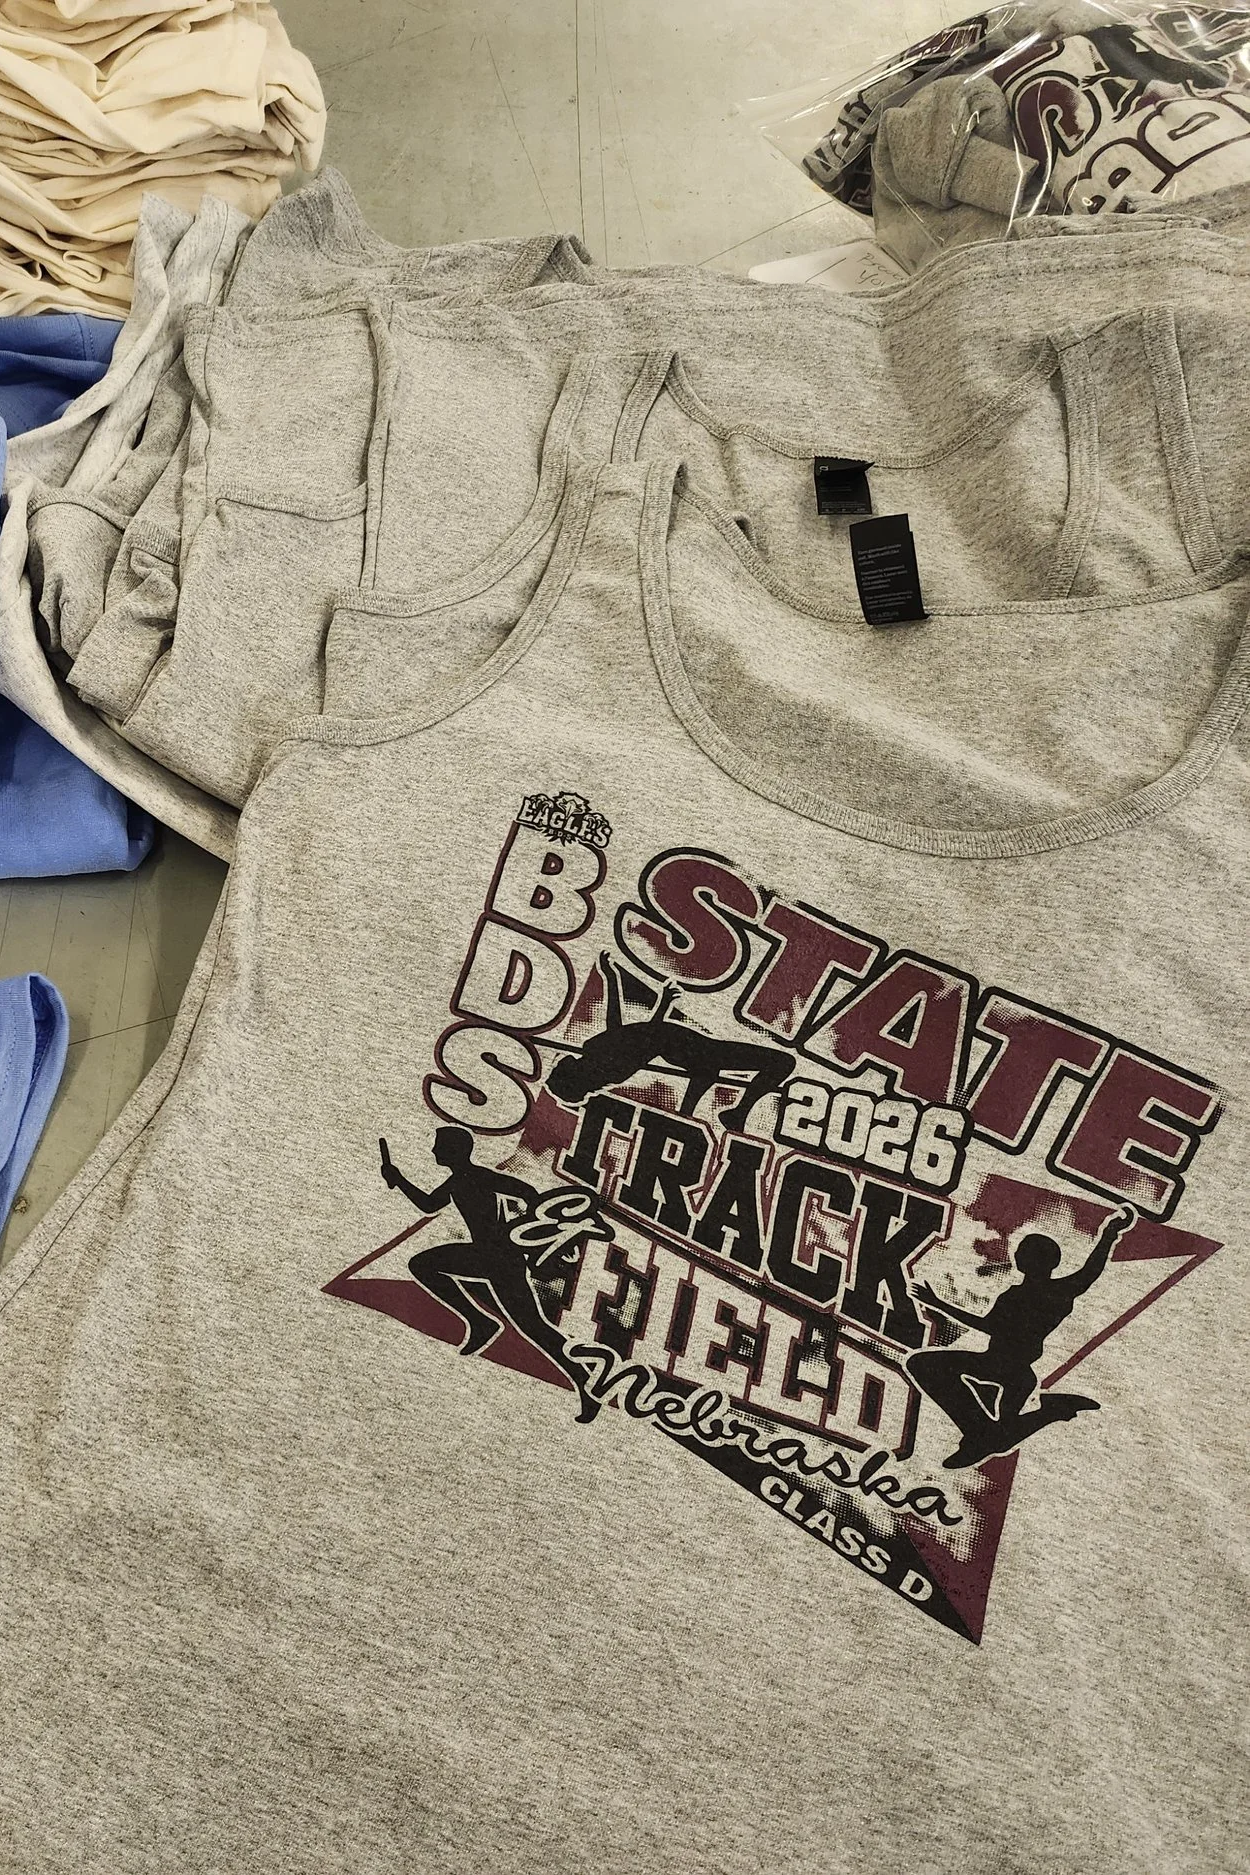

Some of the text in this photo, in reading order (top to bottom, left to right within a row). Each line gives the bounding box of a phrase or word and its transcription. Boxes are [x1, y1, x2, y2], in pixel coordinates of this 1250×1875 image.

[516, 798, 613, 849] EAGLES
[613, 846, 1225, 1222] STATE
[555, 1096, 953, 1352] TRACK
[778, 1077, 974, 1193] 2026
[558, 1214, 920, 1458] FIELD
[564, 1342, 963, 1528] Nebraska
[759, 1475, 935, 1602] CLASS D
